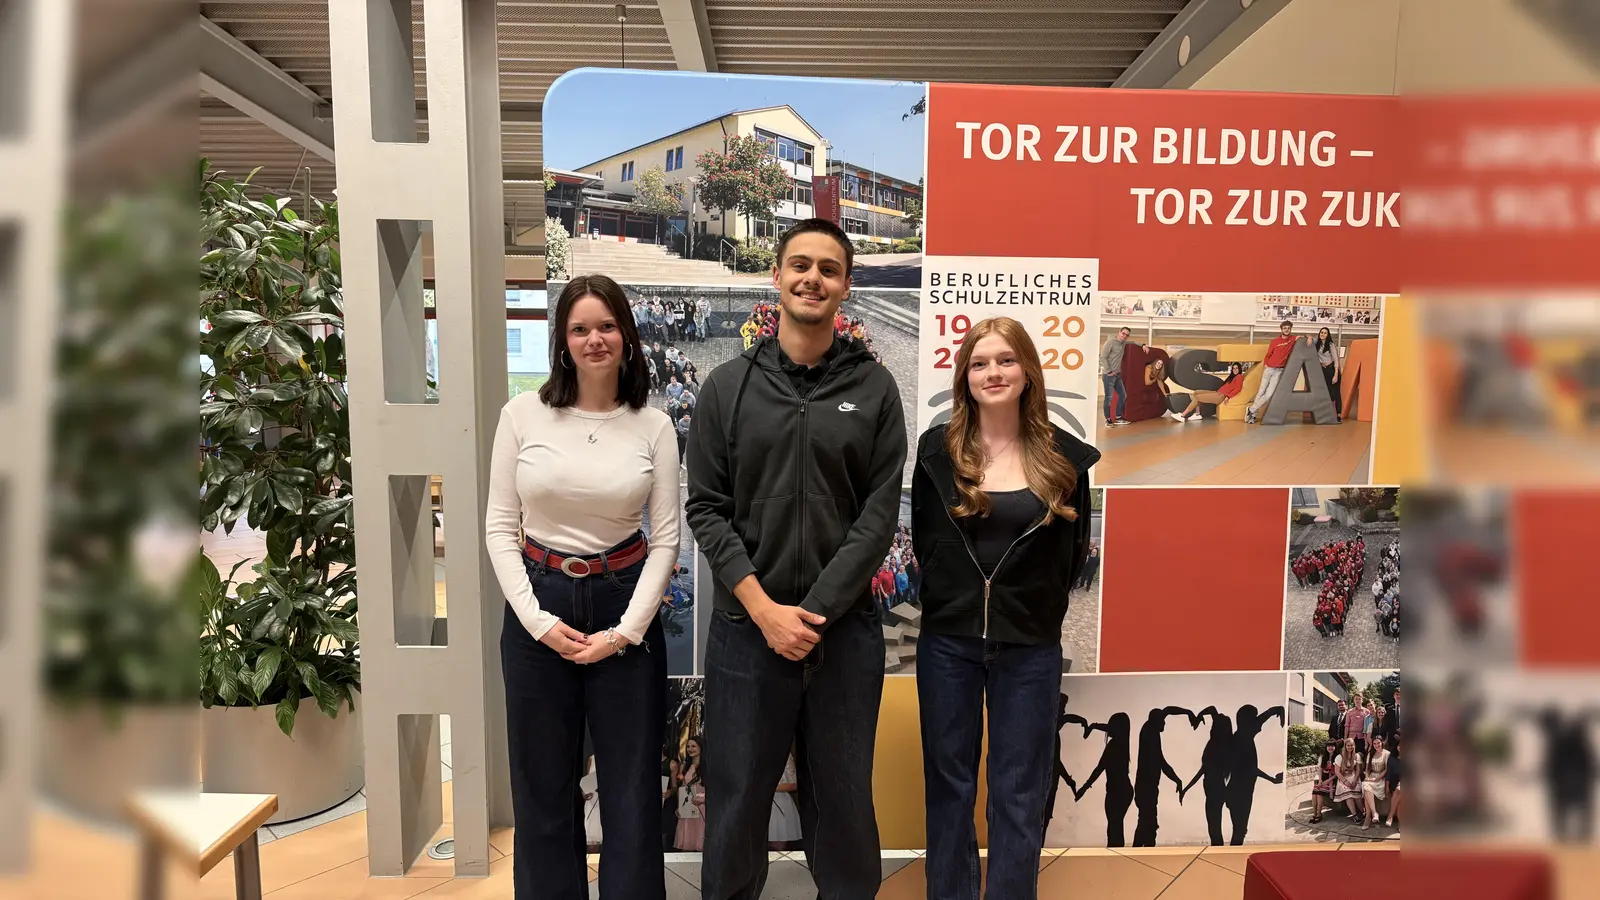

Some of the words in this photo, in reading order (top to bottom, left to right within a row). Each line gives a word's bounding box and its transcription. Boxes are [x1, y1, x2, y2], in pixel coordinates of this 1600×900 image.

[955, 121, 1042, 161] TOR
[1054, 125, 1139, 163] ZUR
[1152, 127, 1337, 167] BILDUNG
[1130, 187, 1213, 225] TOR
[1224, 189, 1308, 226] ZUR
[1319, 190, 1400, 228] ZUK
[930, 272, 1092, 289] BERUFLICHES
[929, 290, 1092, 306] SCHULZENTRUM
[935, 314, 972, 345] 19
[1042, 315, 1085, 338] 20
[933, 347, 962, 369] 2
[1041, 348, 1084, 371] 20
